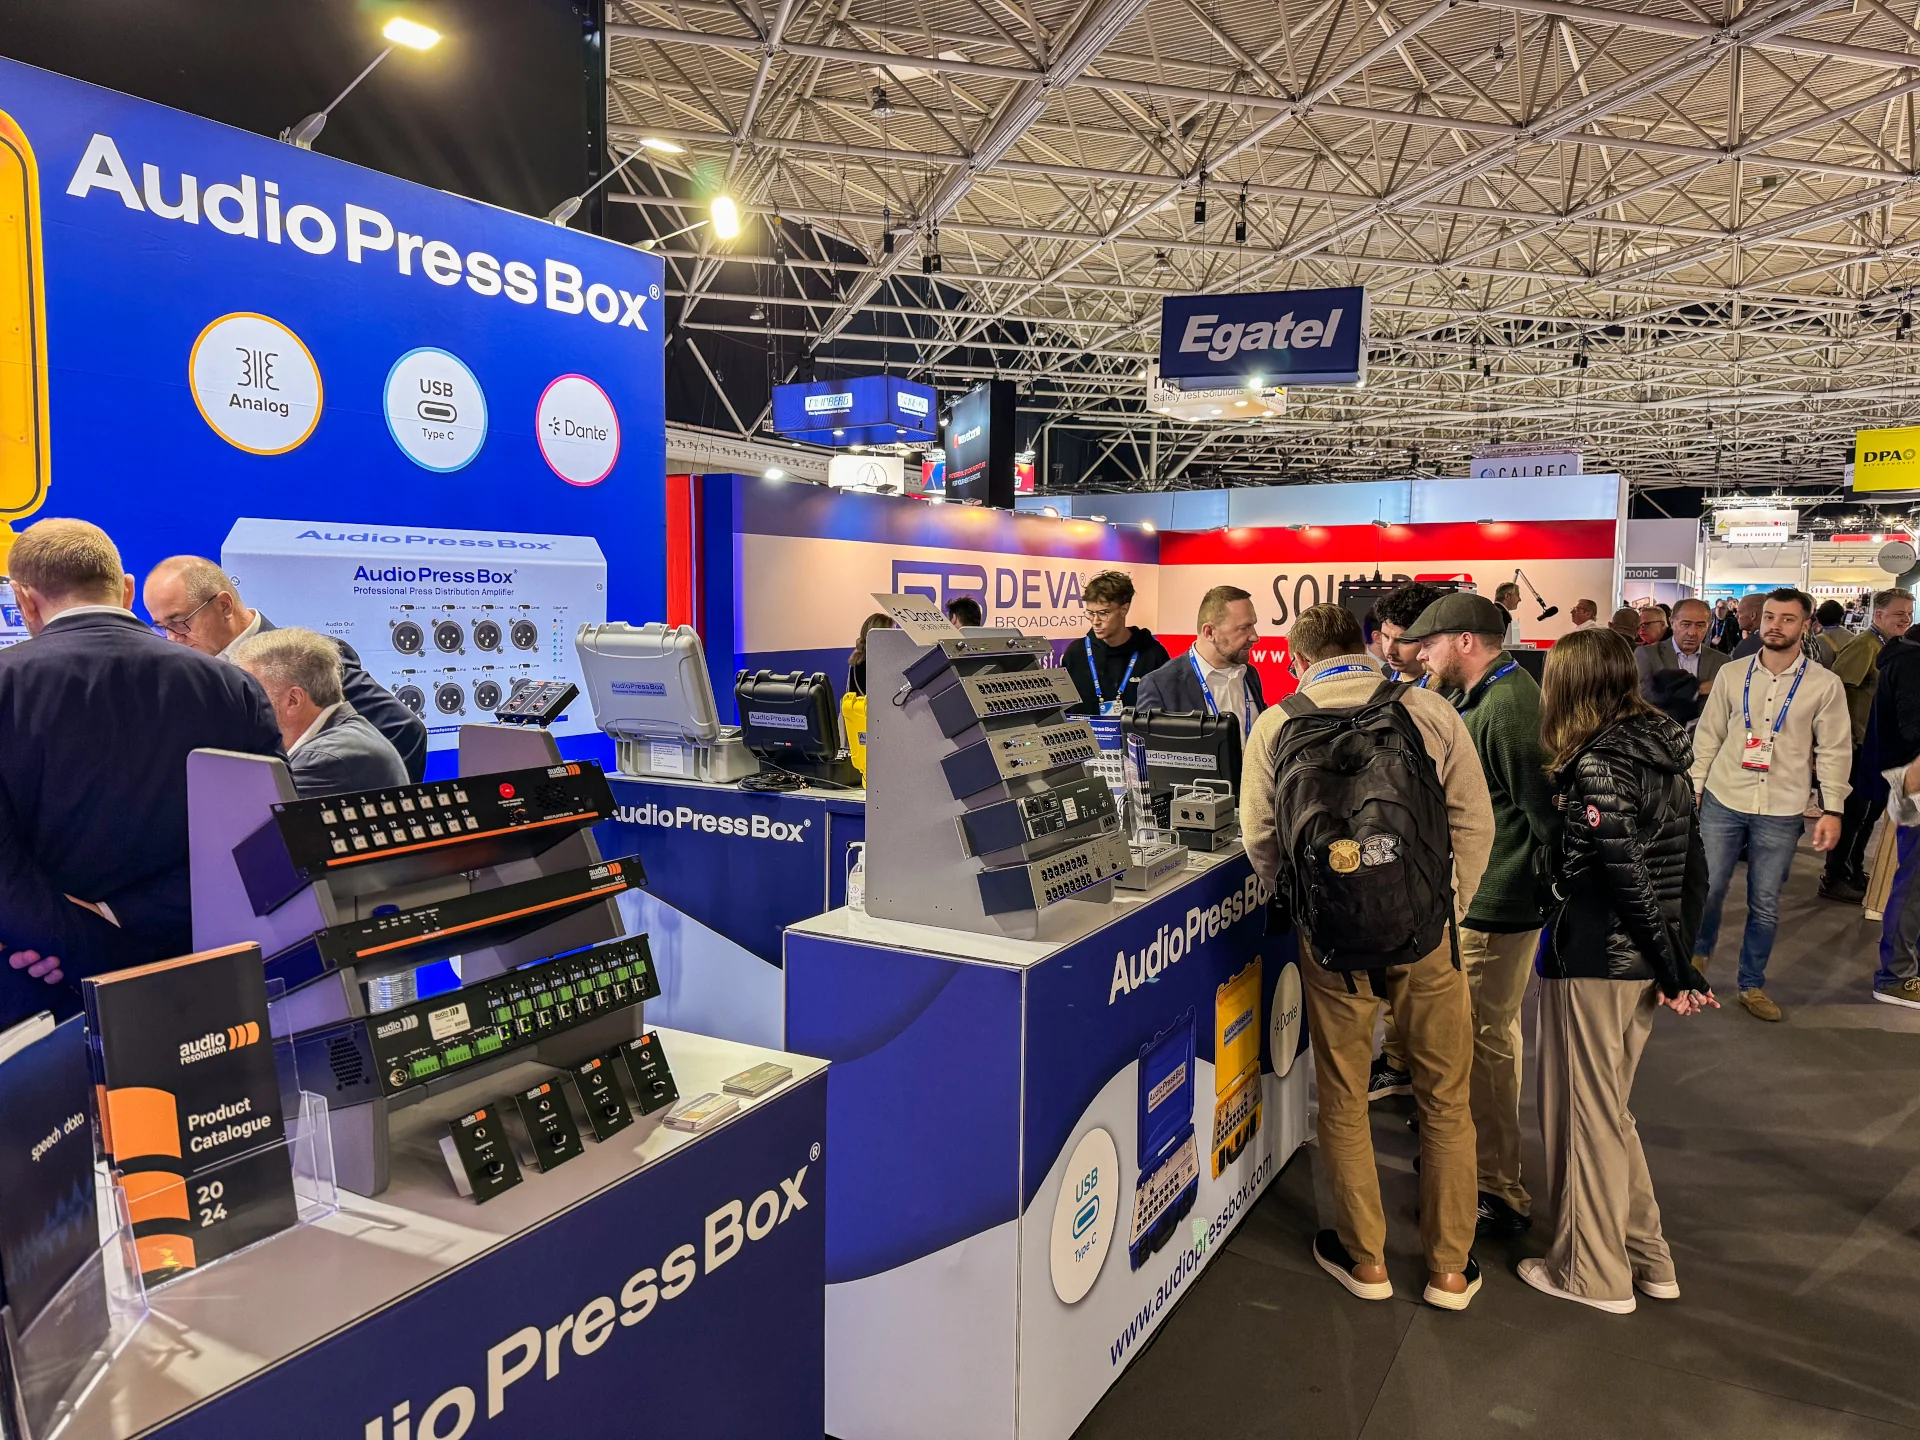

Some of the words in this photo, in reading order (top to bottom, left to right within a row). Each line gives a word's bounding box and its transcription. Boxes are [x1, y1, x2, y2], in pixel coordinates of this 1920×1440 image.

[1179, 308, 1343, 362] Egatel
[420, 378, 454, 398] USB
[1154, 392, 1180, 402] Safety
[1184, 391, 1200, 400] Test
[229, 393, 290, 418] Analog
[421, 427, 444, 441] Type
[446, 430, 455, 441] C
[565, 419, 608, 442] Dante
[1864, 450, 1902, 462] DPA
[354, 586, 407, 595] Professional
[409, 587, 433, 596] Press
[435, 587, 480, 596] Distribution
[481, 588, 514, 597] Amplifier
[903, 608, 944, 622] Dante
[995, 615, 1085, 628] BROADCAST
[750, 714, 806, 724] AudioPressBox
[1146, 752, 1214, 764] udioPressBox
[547, 766, 567, 775] audio
[588, 866, 608, 876] audio
[1109, 872, 1270, 1006] AudioPressBo
[376, 1020, 401, 1035] audio
[179, 1031, 226, 1059] audio
[180, 1045, 227, 1066] resolution
[526, 1088, 540, 1098] audio
[187, 1097, 252, 1132] Product
[461, 1114, 476, 1125] audio
[190, 1114, 272, 1154] Catalogue
[196, 1180, 224, 1206] 20
[1075, 1166, 1099, 1203] USB
[200, 1202, 228, 1228] 24
[1074, 1241, 1091, 1263] Type
[1091, 1231, 1098, 1245] C
[1110, 1152, 1272, 1367] www.audiopressbox.com
